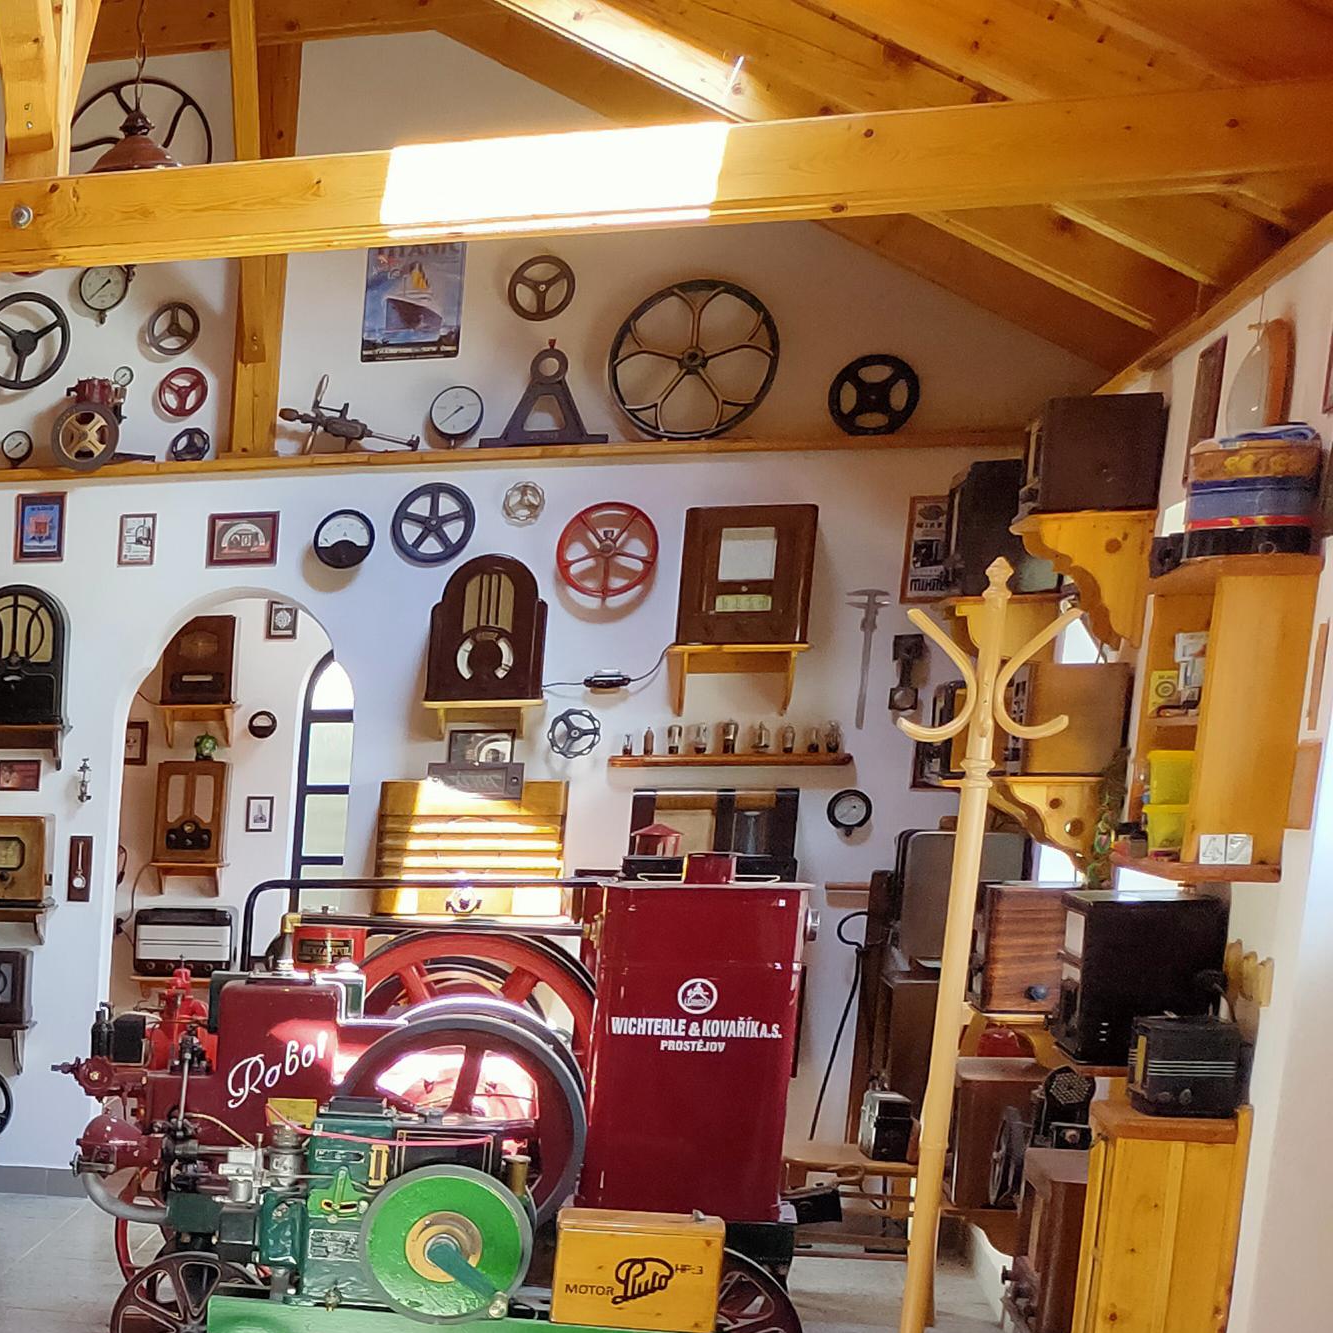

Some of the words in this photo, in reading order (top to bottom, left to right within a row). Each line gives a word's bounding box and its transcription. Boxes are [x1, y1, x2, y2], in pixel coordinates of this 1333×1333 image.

[611, 1016, 687, 1037] WICHTERLE
[688, 1021, 701, 1037] &
[702, 1016, 759, 1039] KOVAŘÍK
[659, 1039, 726, 1053] PROSTĚJOV
[564, 1284, 615, 1296] MOTOR
